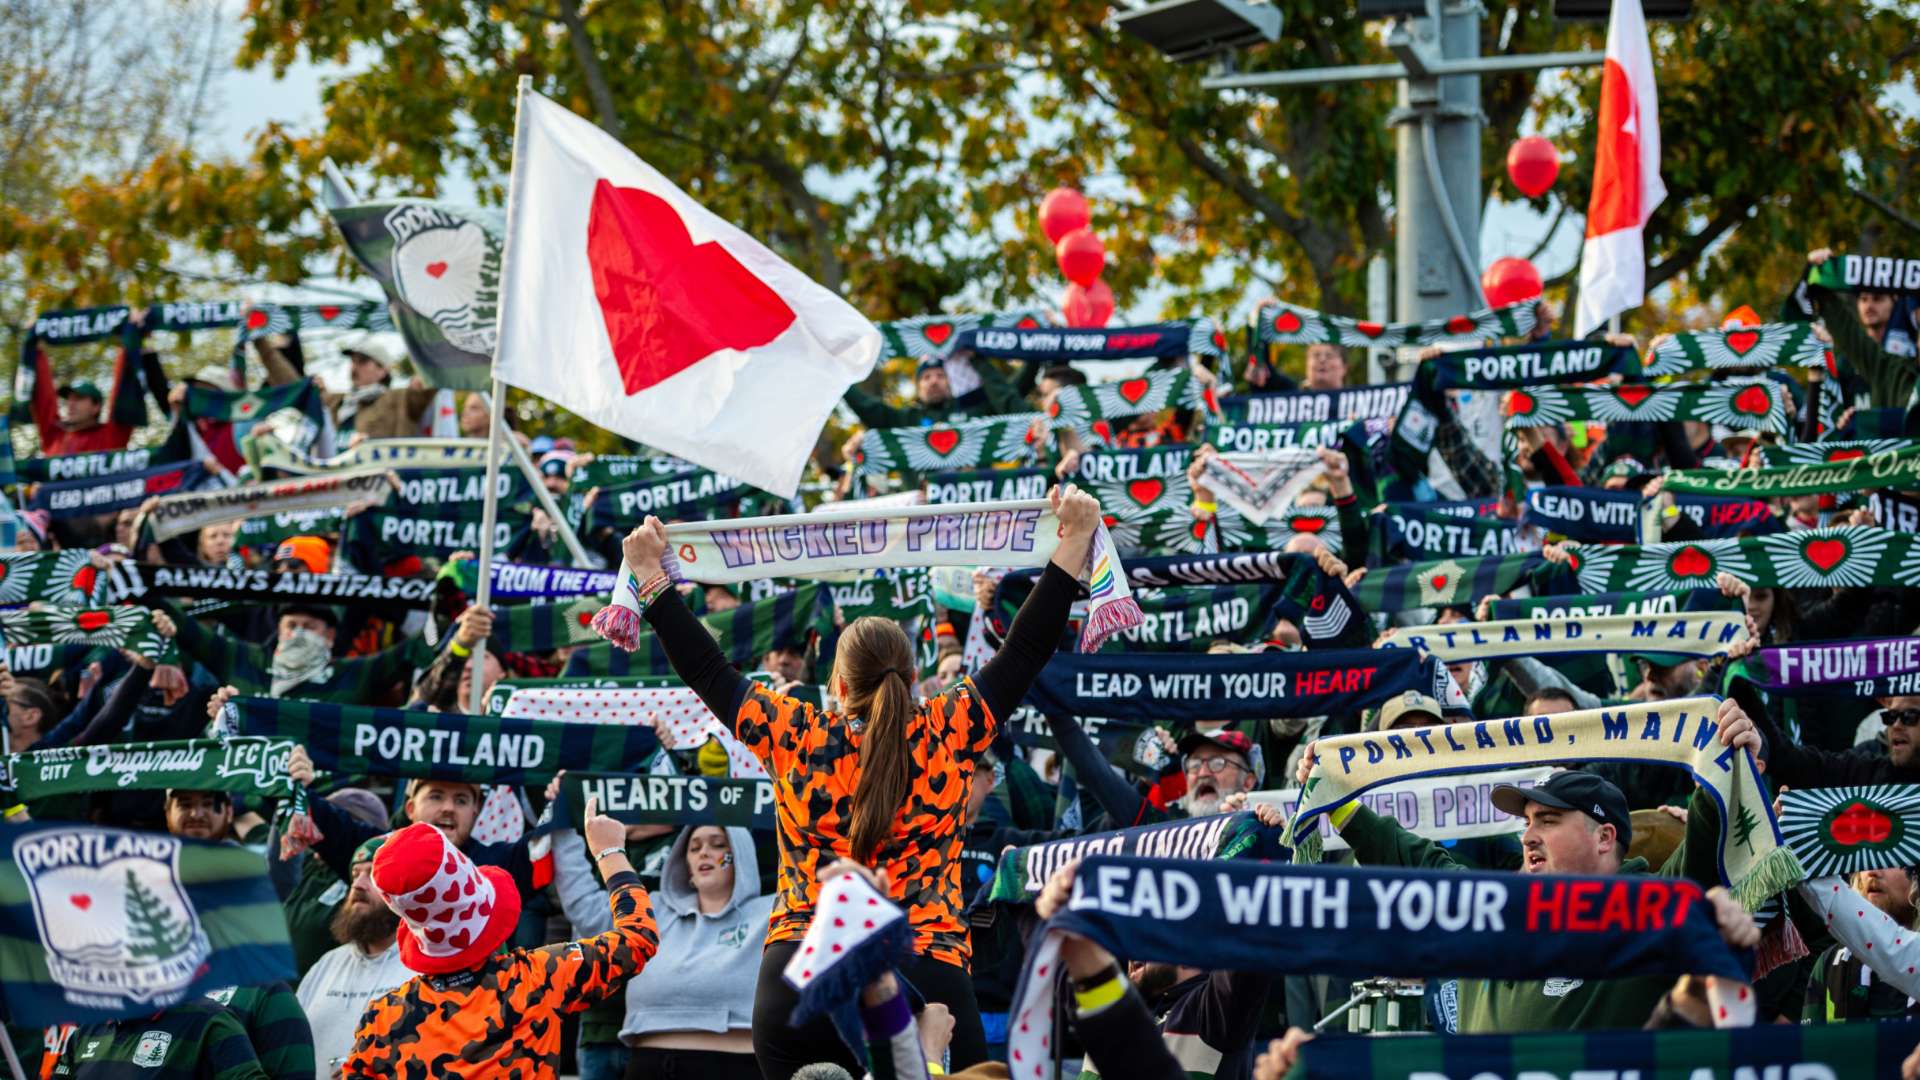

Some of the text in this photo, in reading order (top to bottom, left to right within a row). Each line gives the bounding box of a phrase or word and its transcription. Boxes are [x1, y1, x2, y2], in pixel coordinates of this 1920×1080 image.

[163, 302, 241, 325] PORTLA
[1464, 346, 1603, 382] PORTLAND
[1247, 394, 1331, 425] DIRIGO
[50, 450, 151, 481] PORTLAND
[1080, 449, 1191, 482] ORTLAN
[1713, 462, 1857, 491] Portland
[926, 474, 1047, 504] PORTLAND
[1532, 493, 1584, 522] LEAD
[381, 515, 511, 549] PORTLAD
[710, 508, 1042, 568] WICKED PRIDE
[154, 568, 269, 592] ALWAYS
[551, 569, 587, 592] THE
[1168, 551, 1286, 584] UNION
[1779, 639, 1920, 685] FROM THE
[1076, 667, 1377, 699] LEAD WITH YOUR HEART
[1854, 679, 1873, 697] TO
[233, 743, 260, 766] FC
[354, 724, 545, 769] PORTLAND
[33, 739, 207, 787] FOREST Originals
[40, 764, 72, 781] CITY
[582, 778, 708, 812] HEARTS
[720, 786, 743, 805] OF
[23, 834, 174, 870] PORTLAND
[1136, 816, 1233, 862] UNION
[1068, 865, 1702, 932] LEAD WITH YOUR HEART
